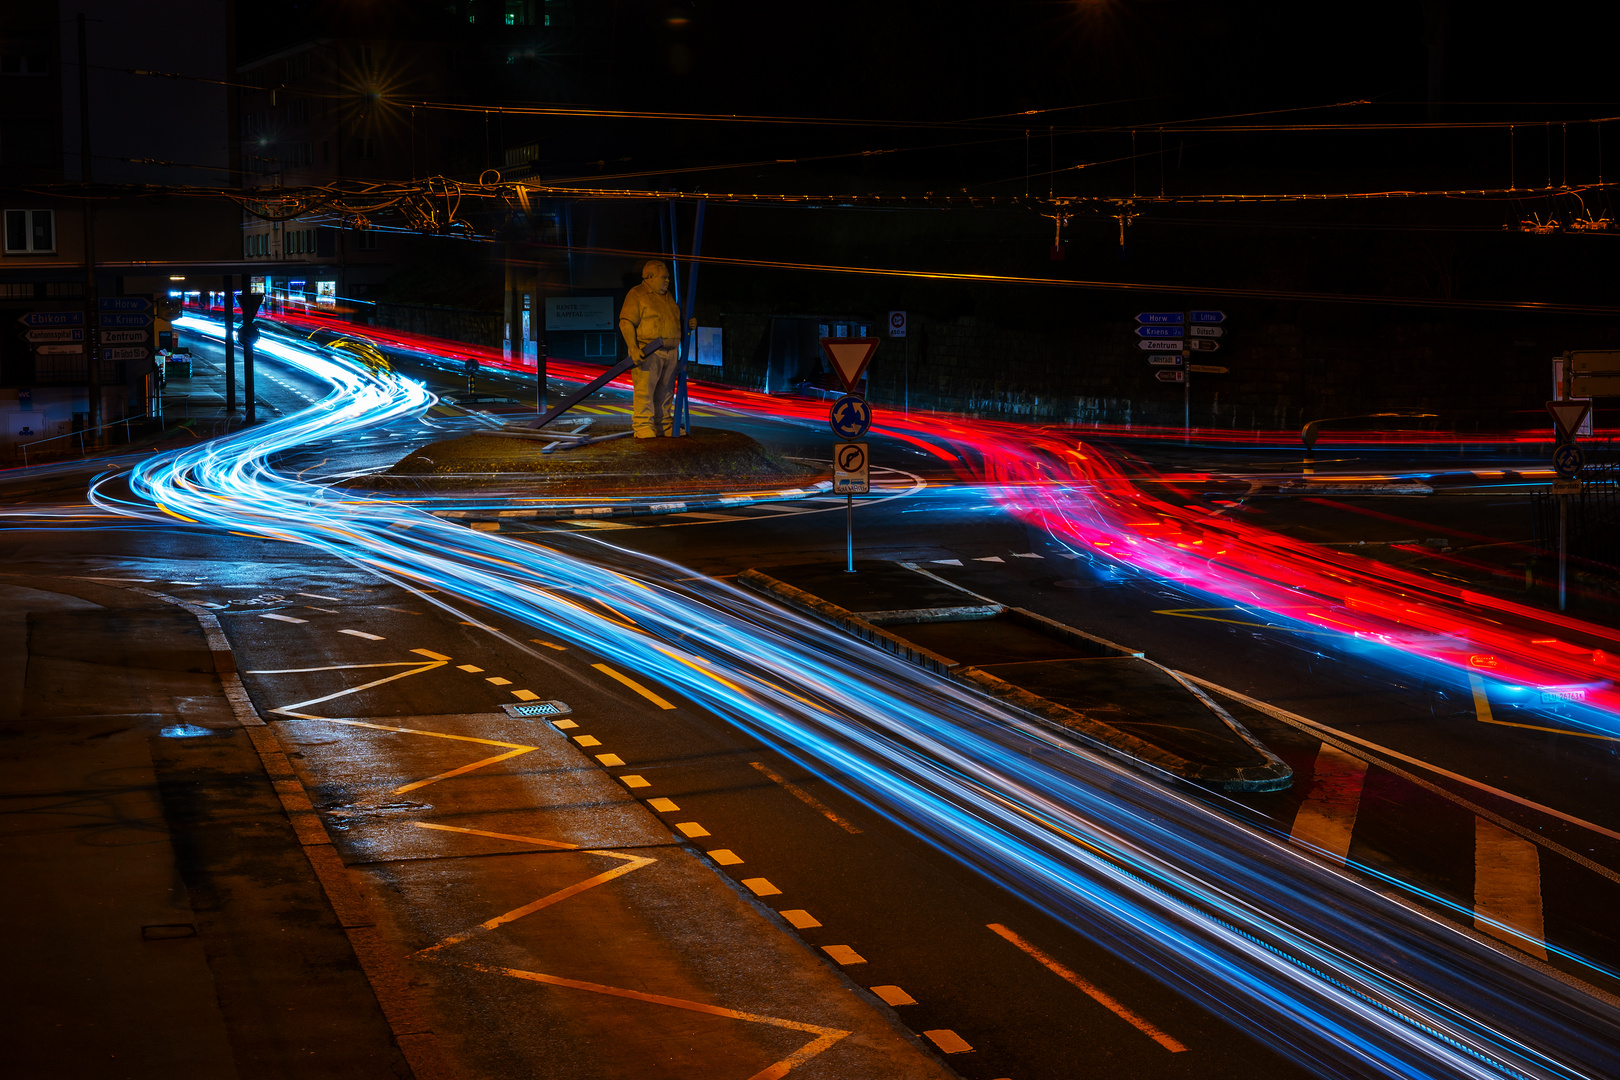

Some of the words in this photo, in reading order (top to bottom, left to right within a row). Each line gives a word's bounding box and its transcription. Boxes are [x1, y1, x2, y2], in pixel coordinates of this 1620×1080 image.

[115, 299, 138, 309] Horw
[31, 314, 66, 324] Ebikon
[116, 315, 144, 324] Kriens
[1200, 313, 1217, 321] Littau
[29, 331, 71, 340] Kantonsspital
[1196, 327, 1215, 335] Gütsch
[106, 332, 142, 341] Zentrum
[1147, 341, 1178, 349] Zentrum
